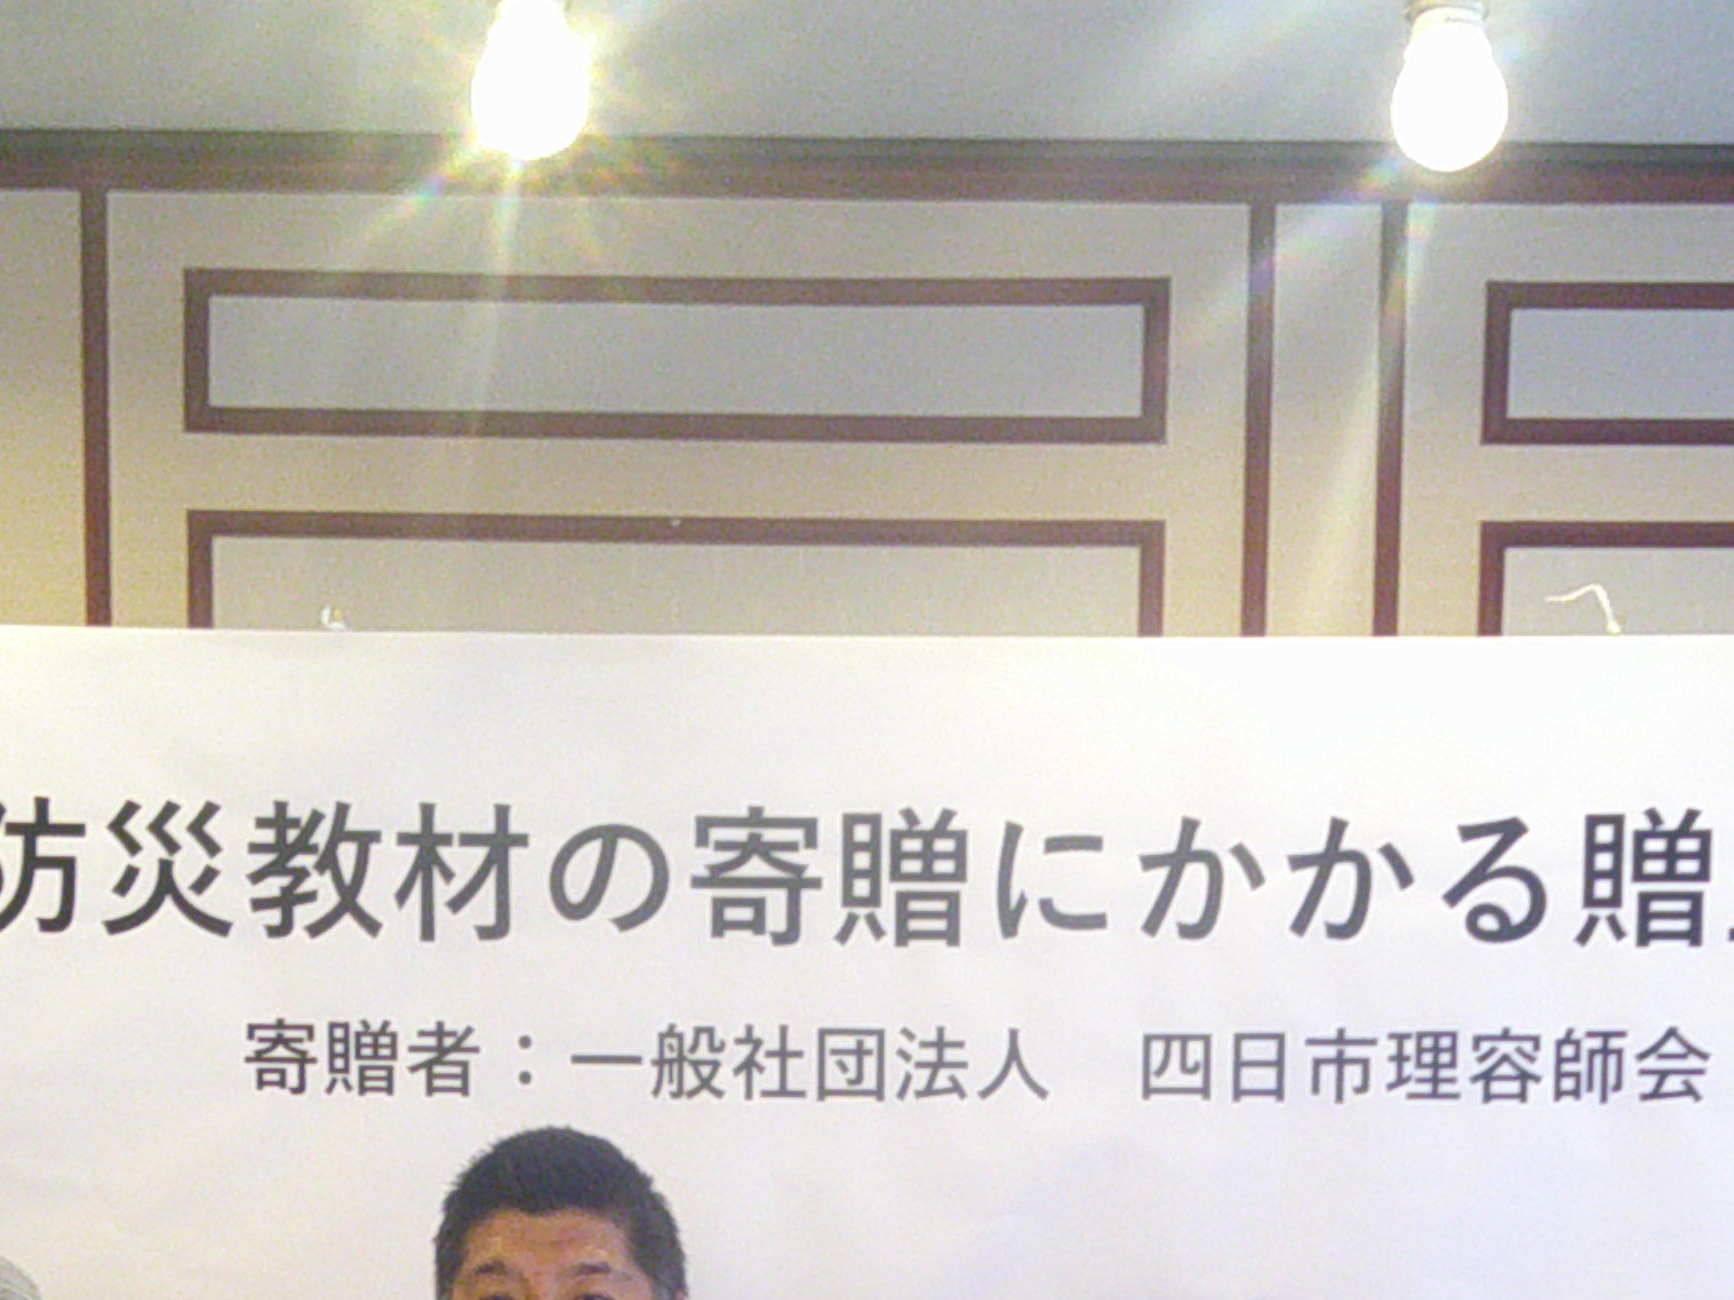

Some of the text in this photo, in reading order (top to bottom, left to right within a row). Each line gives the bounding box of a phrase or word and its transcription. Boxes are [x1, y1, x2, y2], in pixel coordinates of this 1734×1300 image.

[243, 1017, 1712, 1105] 寄贈者：一般社団法人 四日市理容師会
